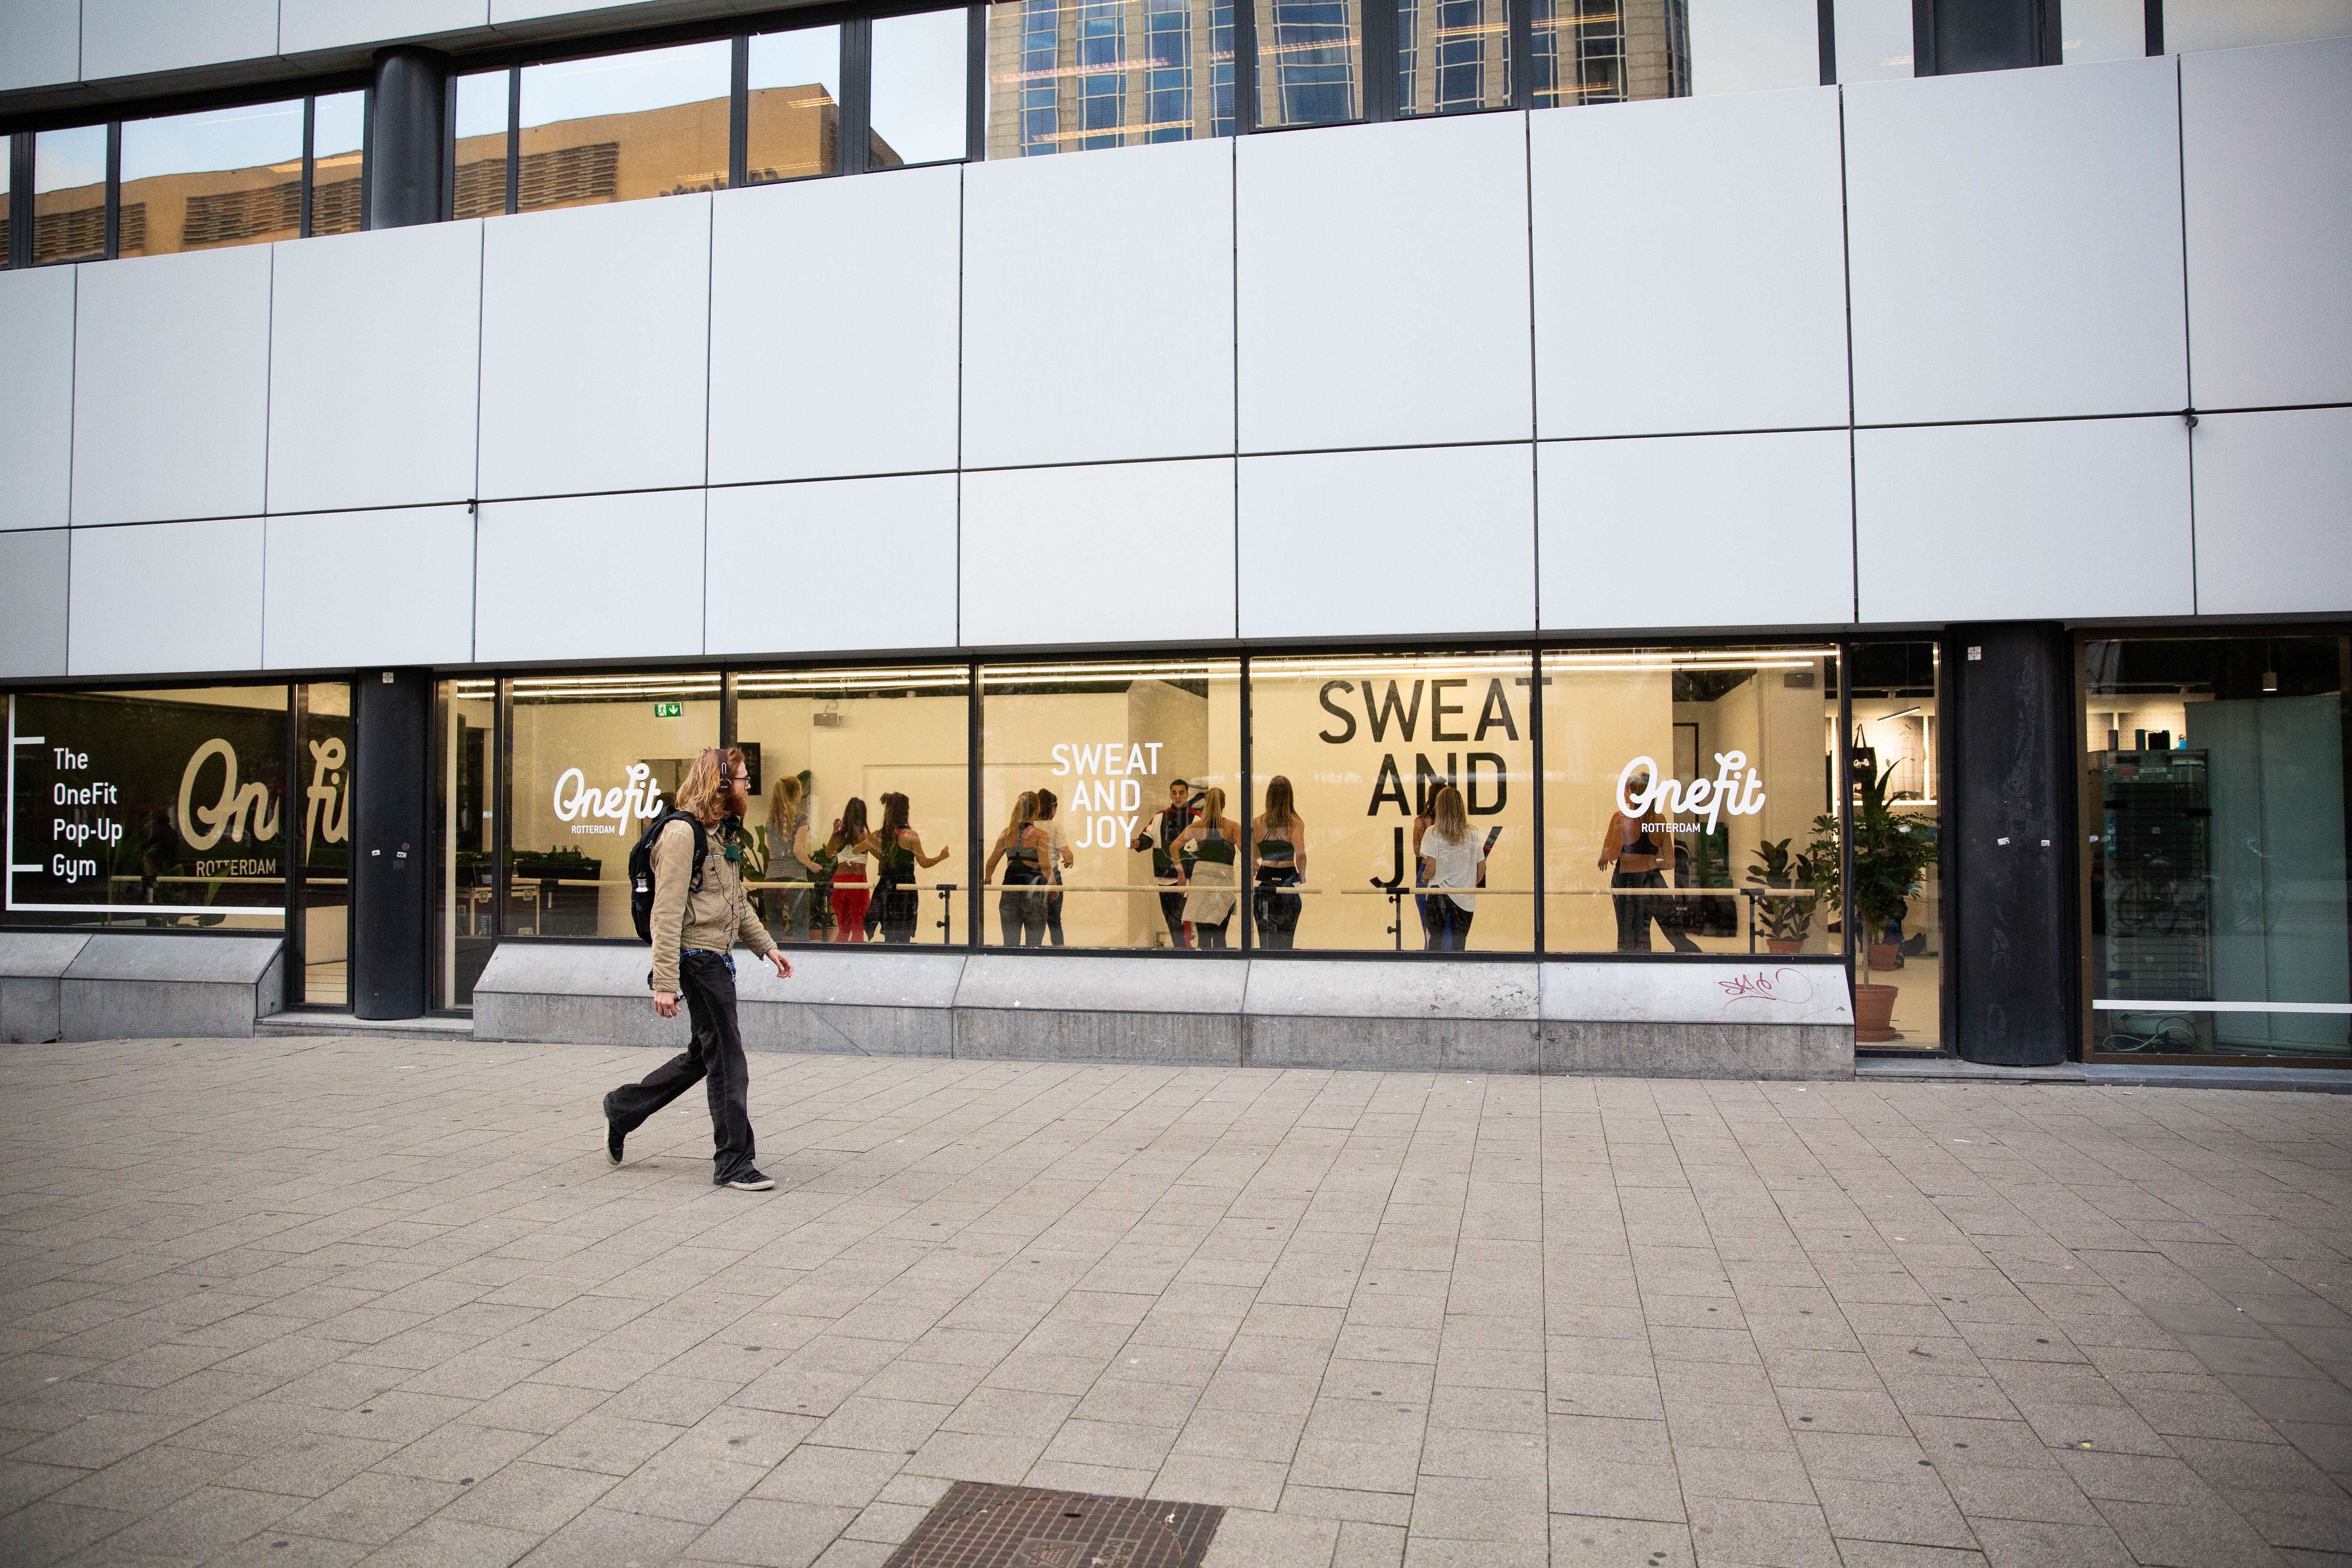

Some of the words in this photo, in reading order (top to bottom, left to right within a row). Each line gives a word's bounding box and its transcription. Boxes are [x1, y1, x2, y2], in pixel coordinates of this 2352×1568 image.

[1319, 677, 1552, 744] SWEAT
[53, 748, 88, 770] The
[1051, 742, 1163, 776] SWEAT
[53, 782, 117, 805] OneFit
[554, 763, 664, 836] Onefit
[1070, 779, 1141, 812] AND
[1367, 752, 1508, 816] AND
[1616, 750, 1766, 835] Onefit
[53, 818, 122, 848] Pop-Up
[571, 825, 615, 834] ROTTERDAM
[1075, 815, 1139, 849] JOY
[1641, 822, 1701, 833] ROTTERDAM
[53, 853, 96, 883] Gym
